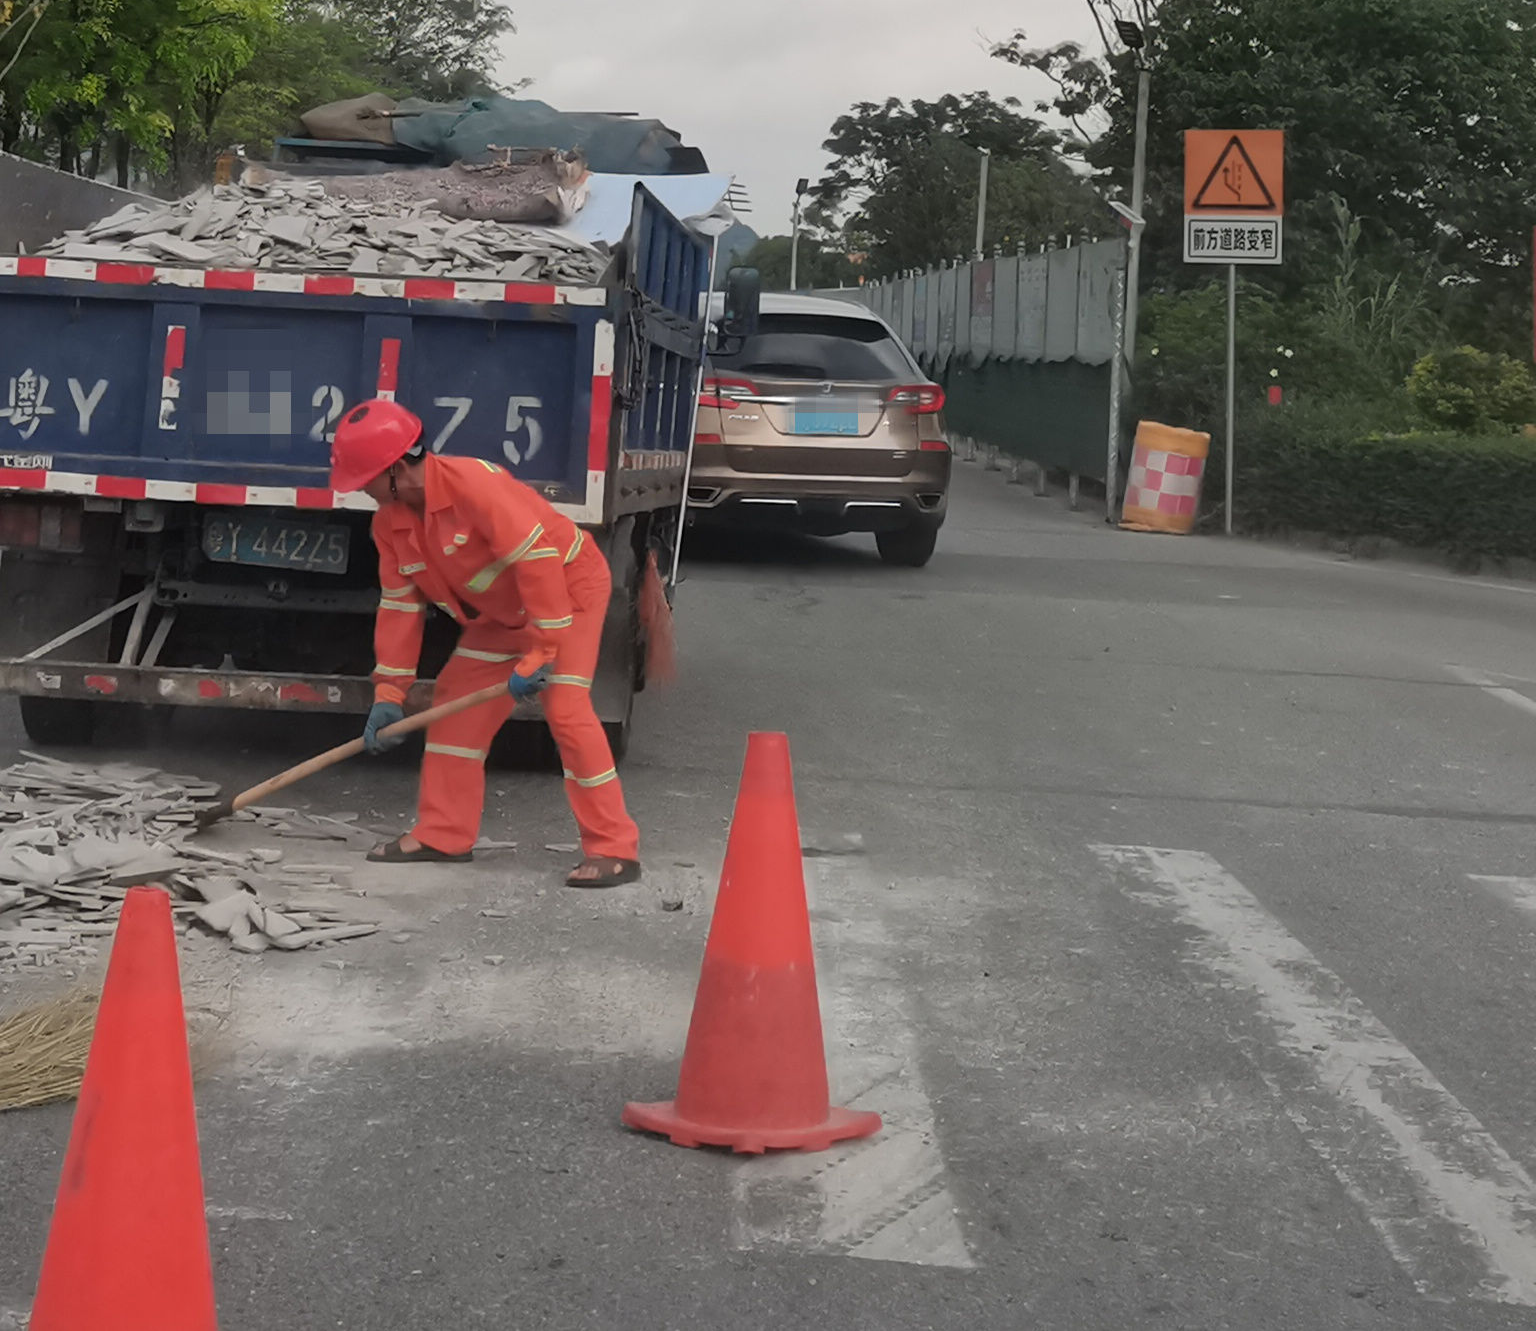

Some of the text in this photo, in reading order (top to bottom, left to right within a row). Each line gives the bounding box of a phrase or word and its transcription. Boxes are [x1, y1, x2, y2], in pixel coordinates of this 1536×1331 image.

[1193, 226, 1273, 252] 前方道路变窄
